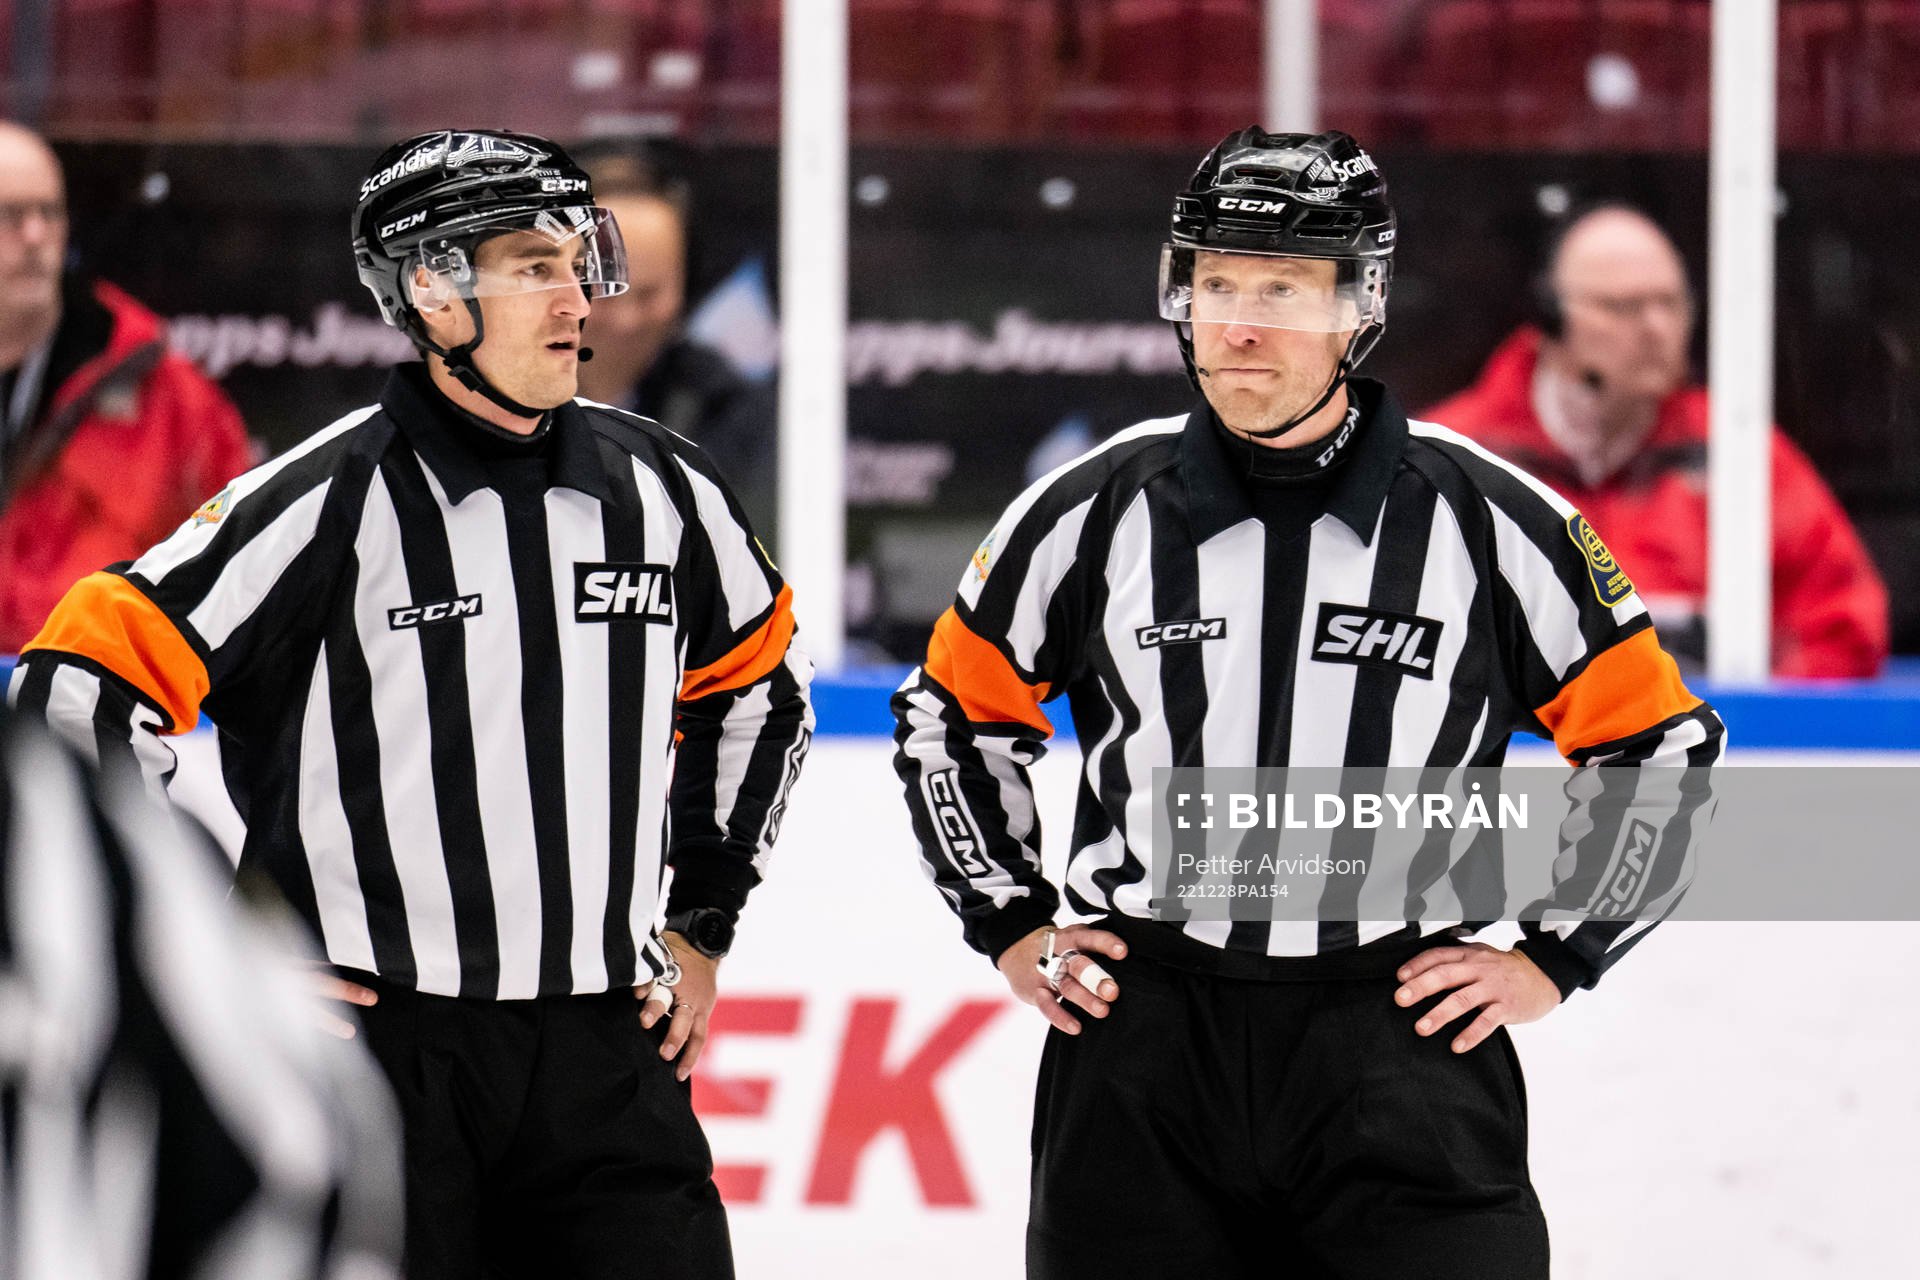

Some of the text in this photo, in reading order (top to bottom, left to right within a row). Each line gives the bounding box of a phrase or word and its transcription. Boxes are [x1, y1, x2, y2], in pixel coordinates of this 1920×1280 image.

[541, 179, 587, 192] CCM
[1217, 197, 1287, 214] CCM
[381, 210, 427, 238] CCM
[1378, 229, 1396, 243] CC
[1314, 406, 1360, 467] CCM
[578, 571, 672, 616] SHL
[392, 597, 480, 627] CCM
[1140, 620, 1222, 646] CCM
[1317, 614, 1431, 669] SHL
[930, 772, 988, 875] CCM
